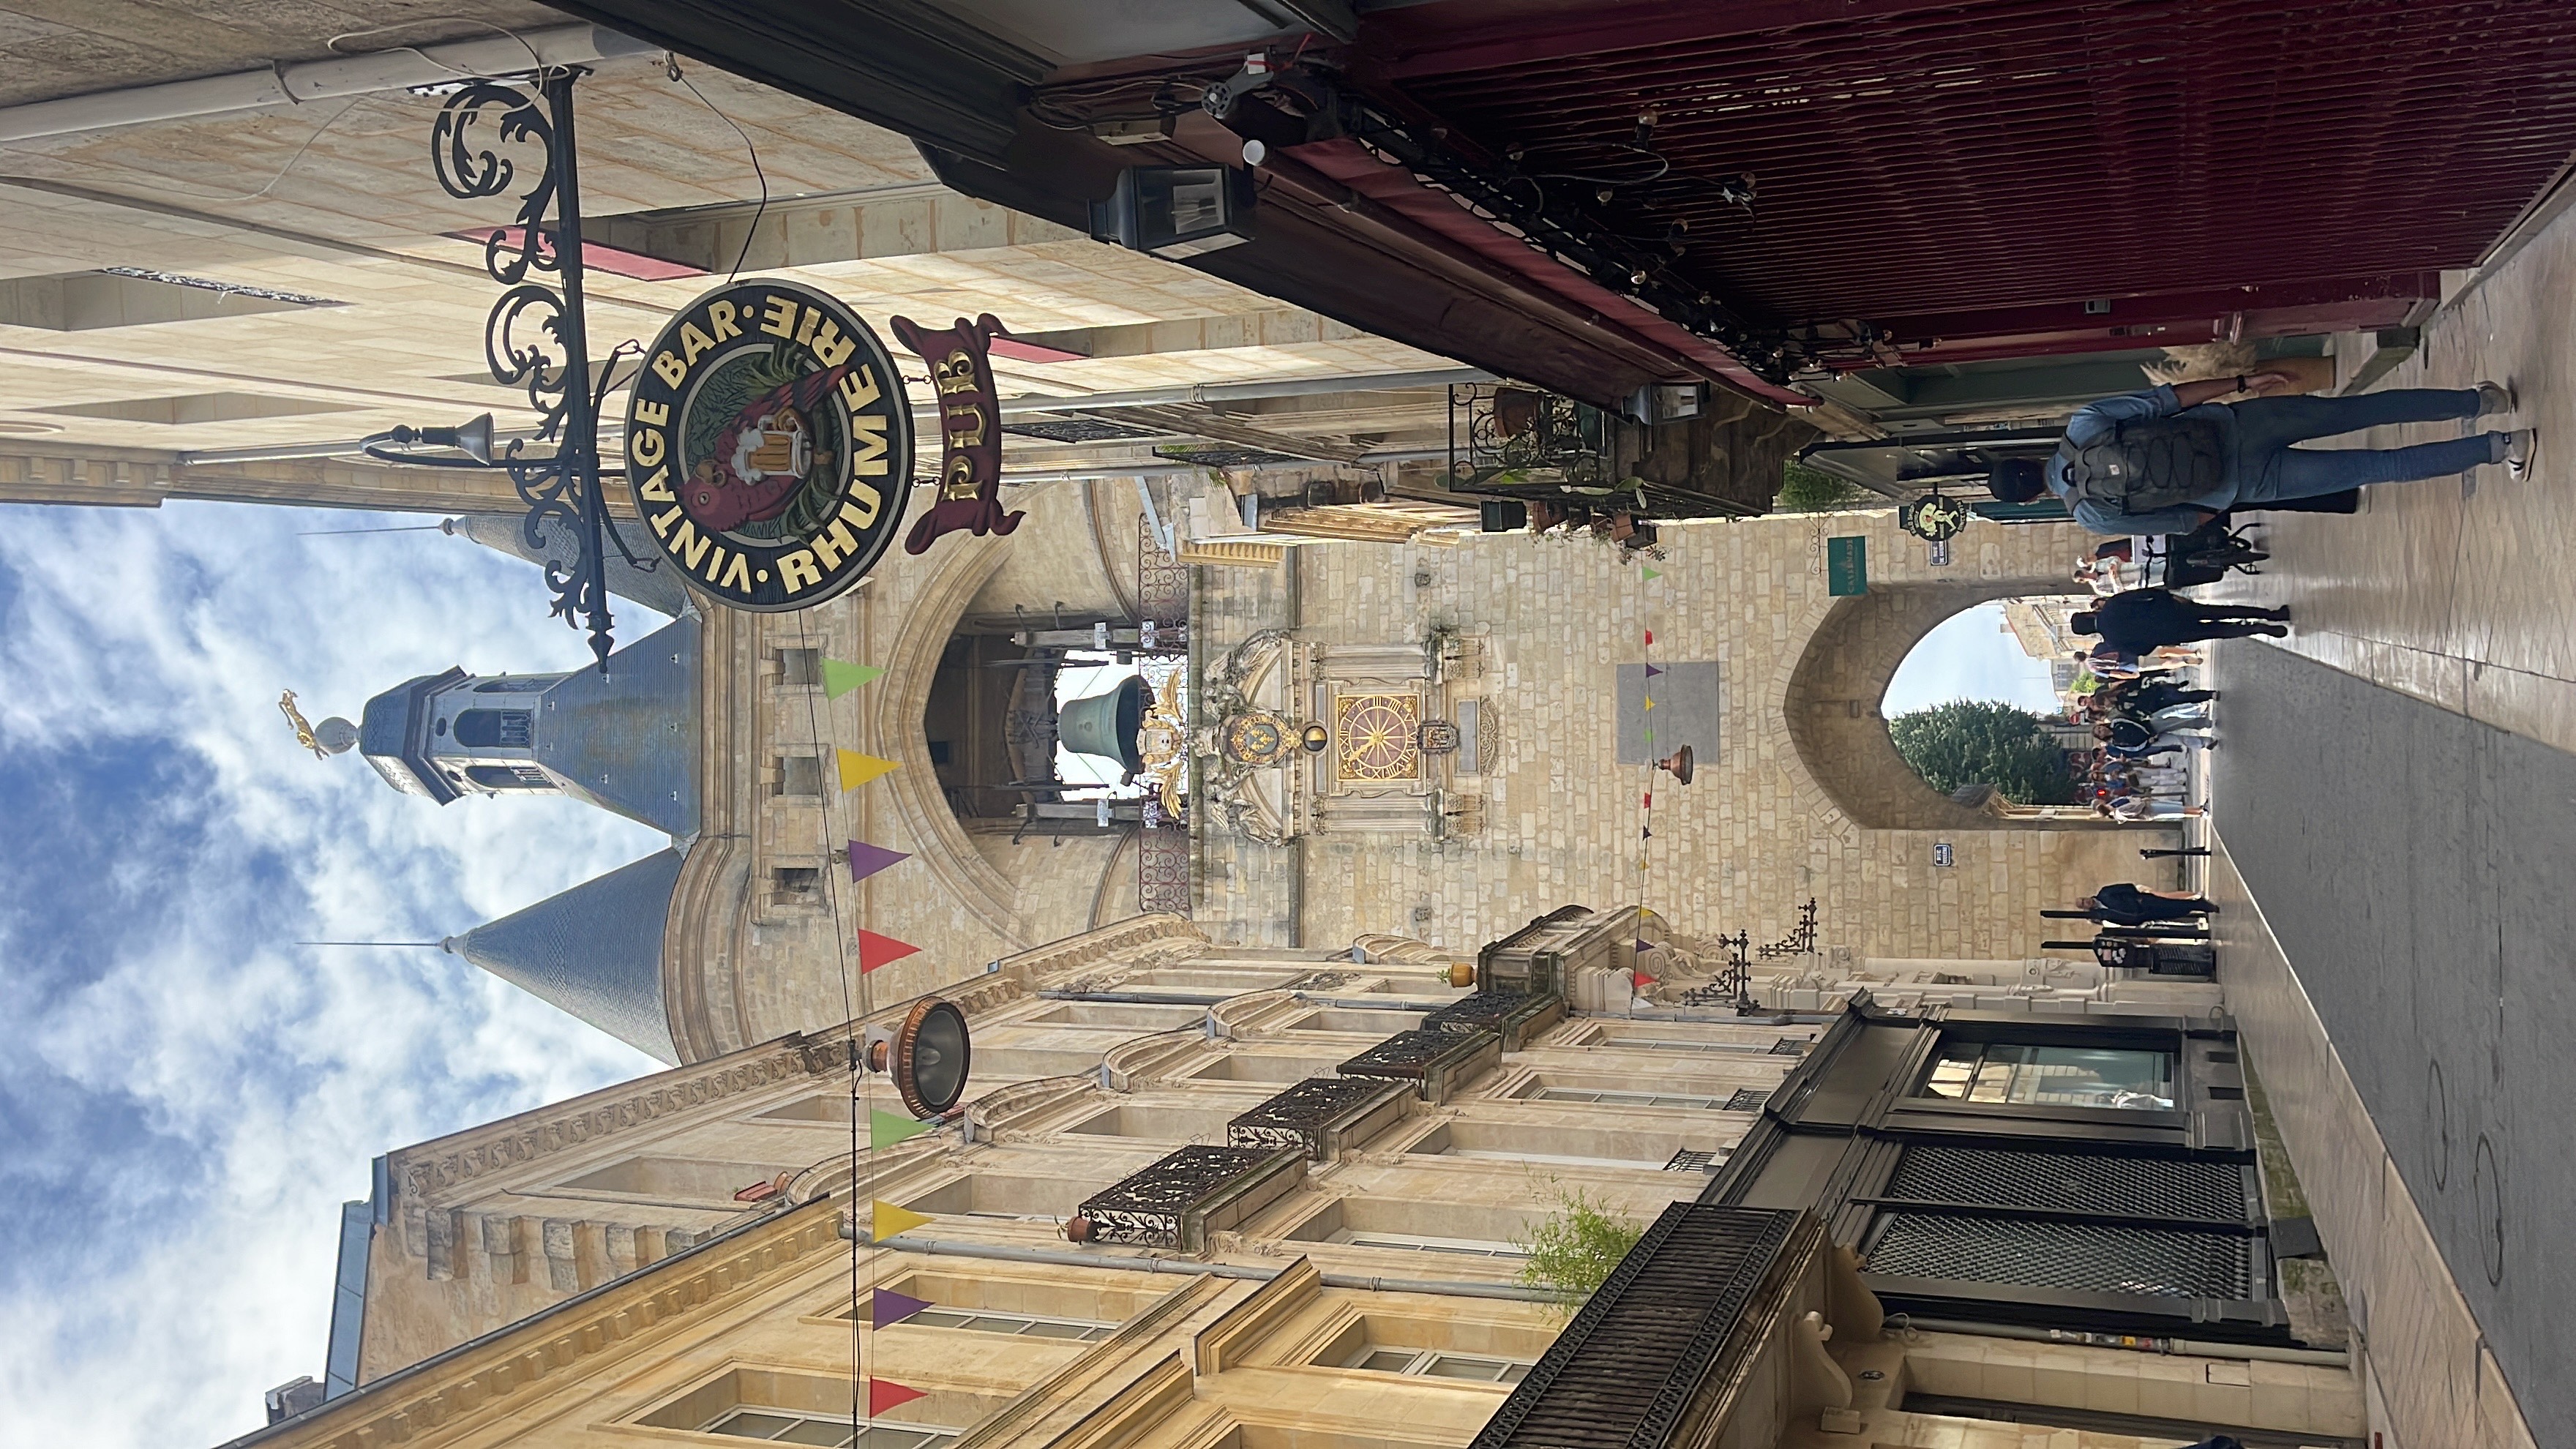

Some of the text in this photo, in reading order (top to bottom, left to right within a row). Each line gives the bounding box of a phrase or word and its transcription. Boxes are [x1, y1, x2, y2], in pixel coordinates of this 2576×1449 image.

[631, 299, 752, 594] VINTAGE BAR
[760, 295, 888, 595] RHUMERIE
[932, 347, 987, 501] PUB
[1340, 730, 1348, 746] XII
[1373, 697, 1382, 706] III
